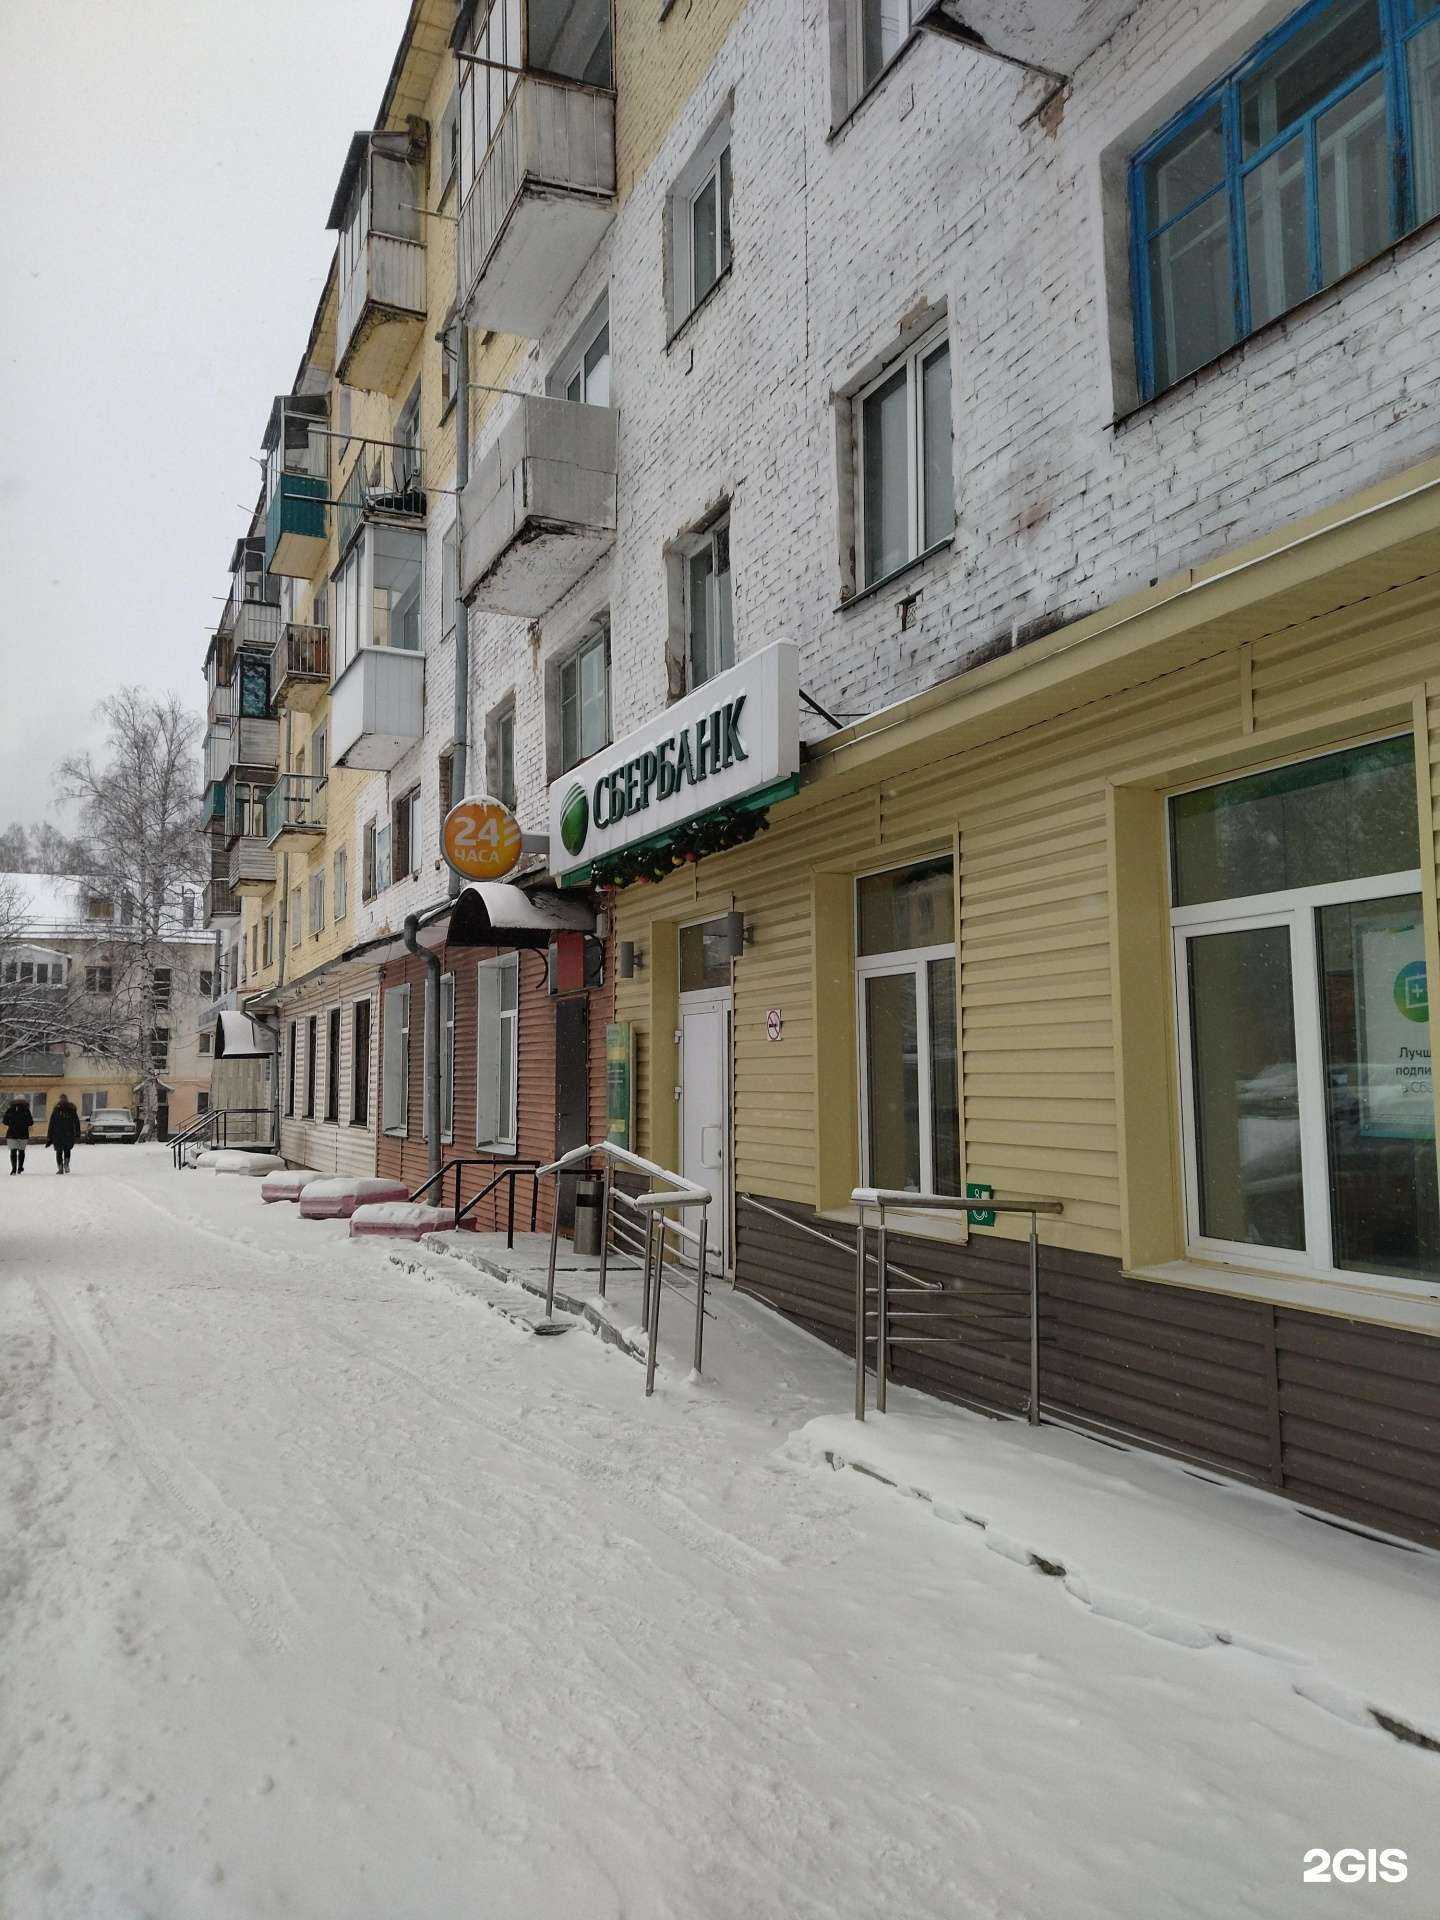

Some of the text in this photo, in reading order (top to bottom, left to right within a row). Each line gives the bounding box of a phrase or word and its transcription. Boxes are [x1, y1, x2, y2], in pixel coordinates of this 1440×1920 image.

[593, 694, 749, 829] СБЕРБАНК
[454, 816, 500, 847] 24
[454, 848, 500, 863] ЧАСА
